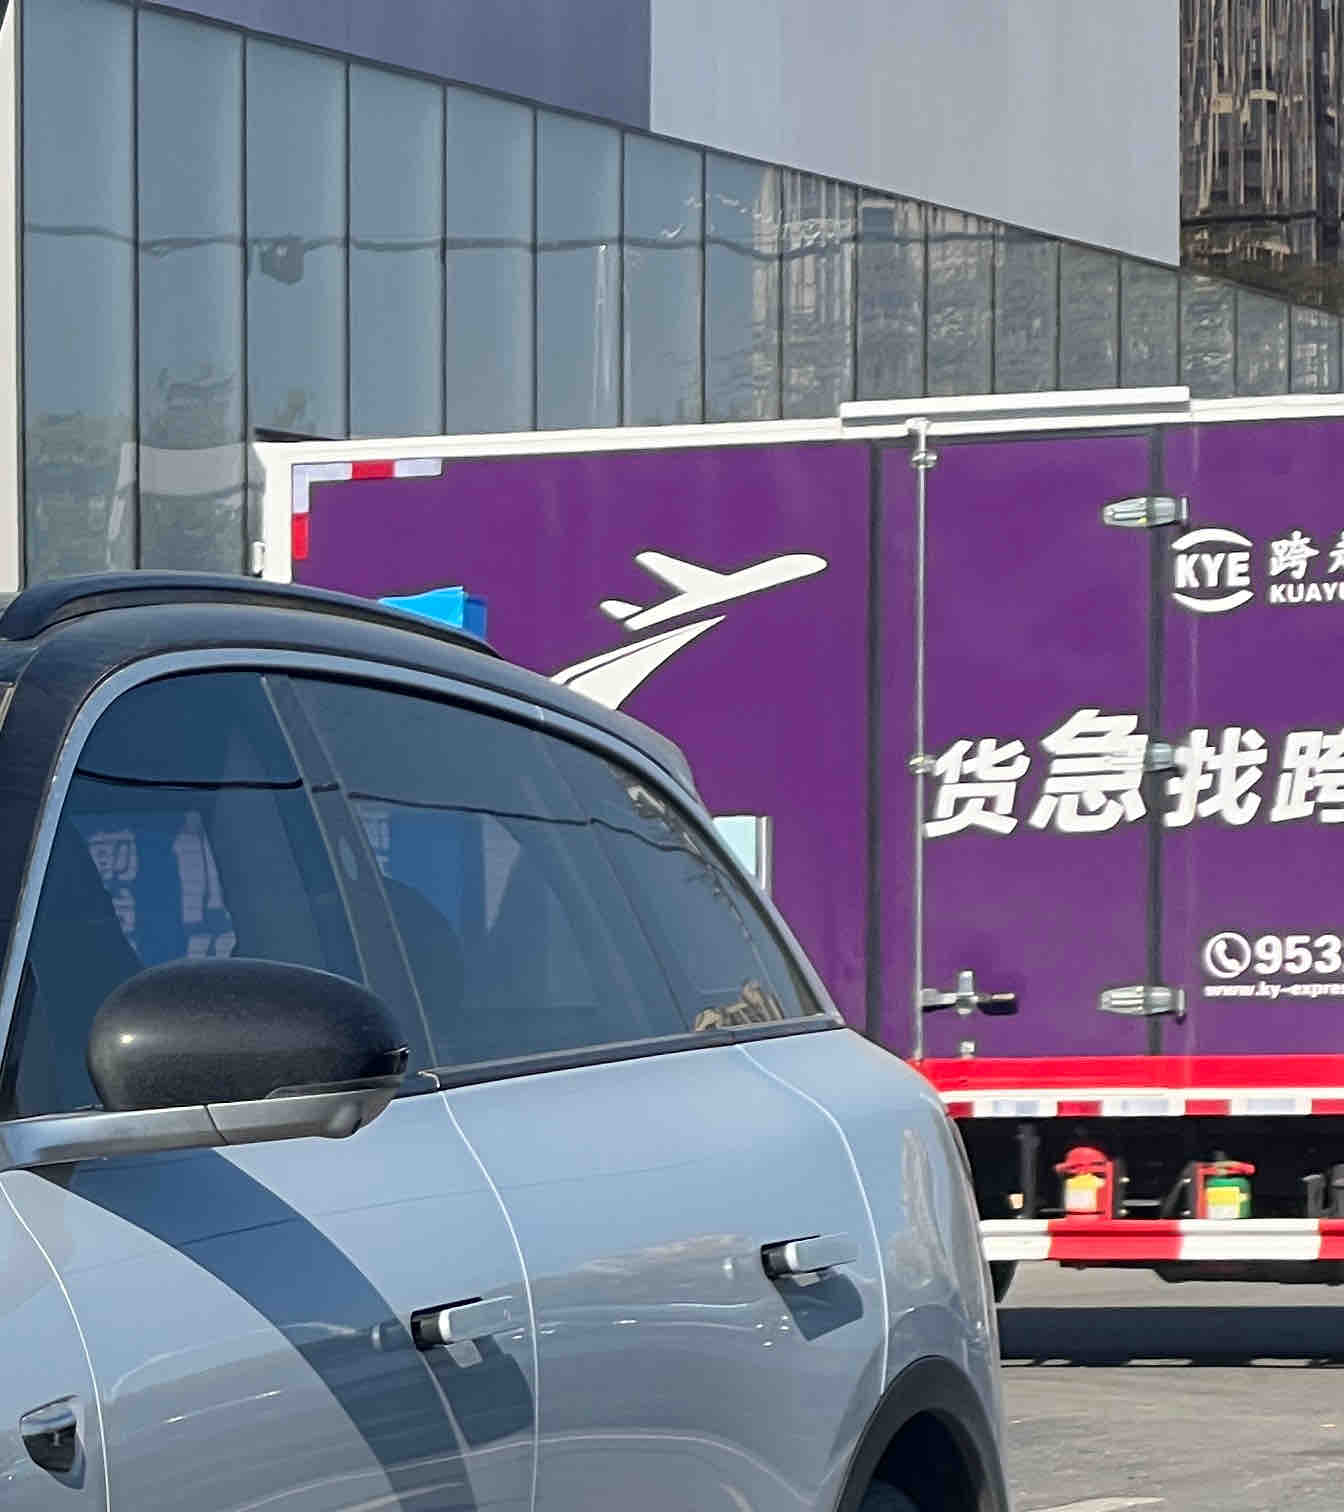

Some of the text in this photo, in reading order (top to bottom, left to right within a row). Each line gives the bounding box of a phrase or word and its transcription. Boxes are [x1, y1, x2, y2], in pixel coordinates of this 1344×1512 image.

[1175, 552, 1251, 588] KYE
[924, 709, 1344, 838] 货急找跨
[1253, 934, 1344, 974] 953
